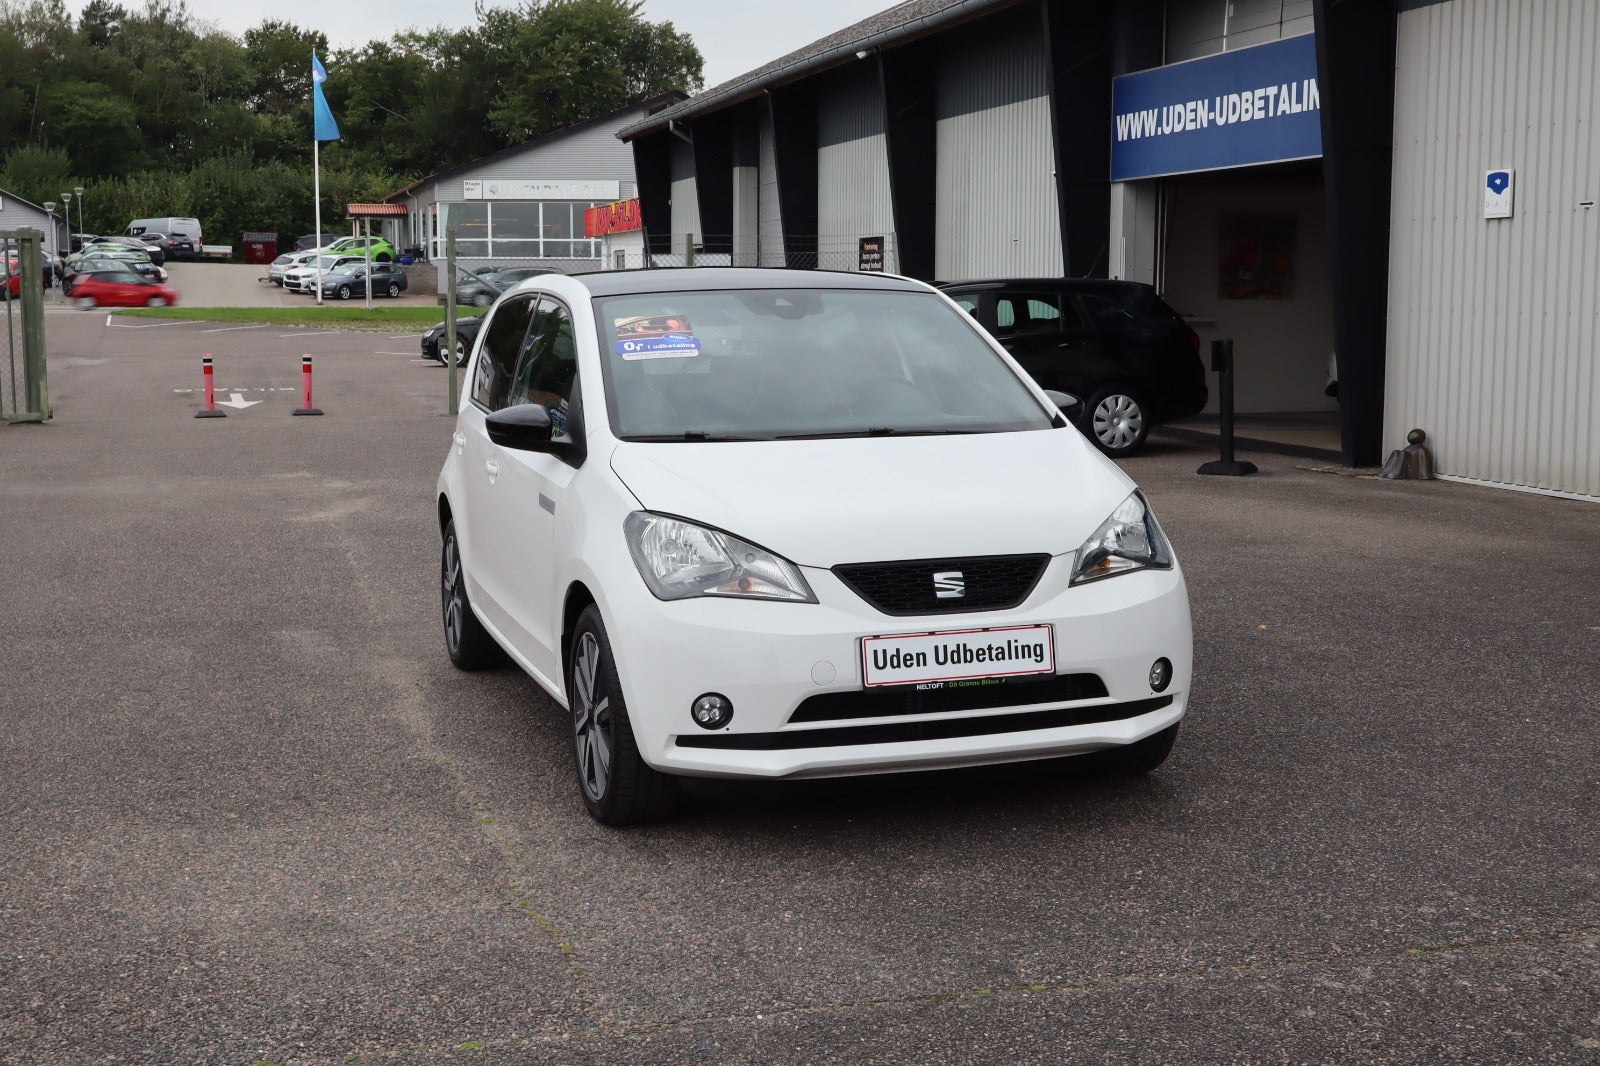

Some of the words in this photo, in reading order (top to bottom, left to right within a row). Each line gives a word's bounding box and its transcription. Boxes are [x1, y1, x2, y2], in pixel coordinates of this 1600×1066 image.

[873, 648, 927, 671] Uden
[933, 639, 1045, 664] Udbetaling
[916, 682, 944, 691] NELTOFT
